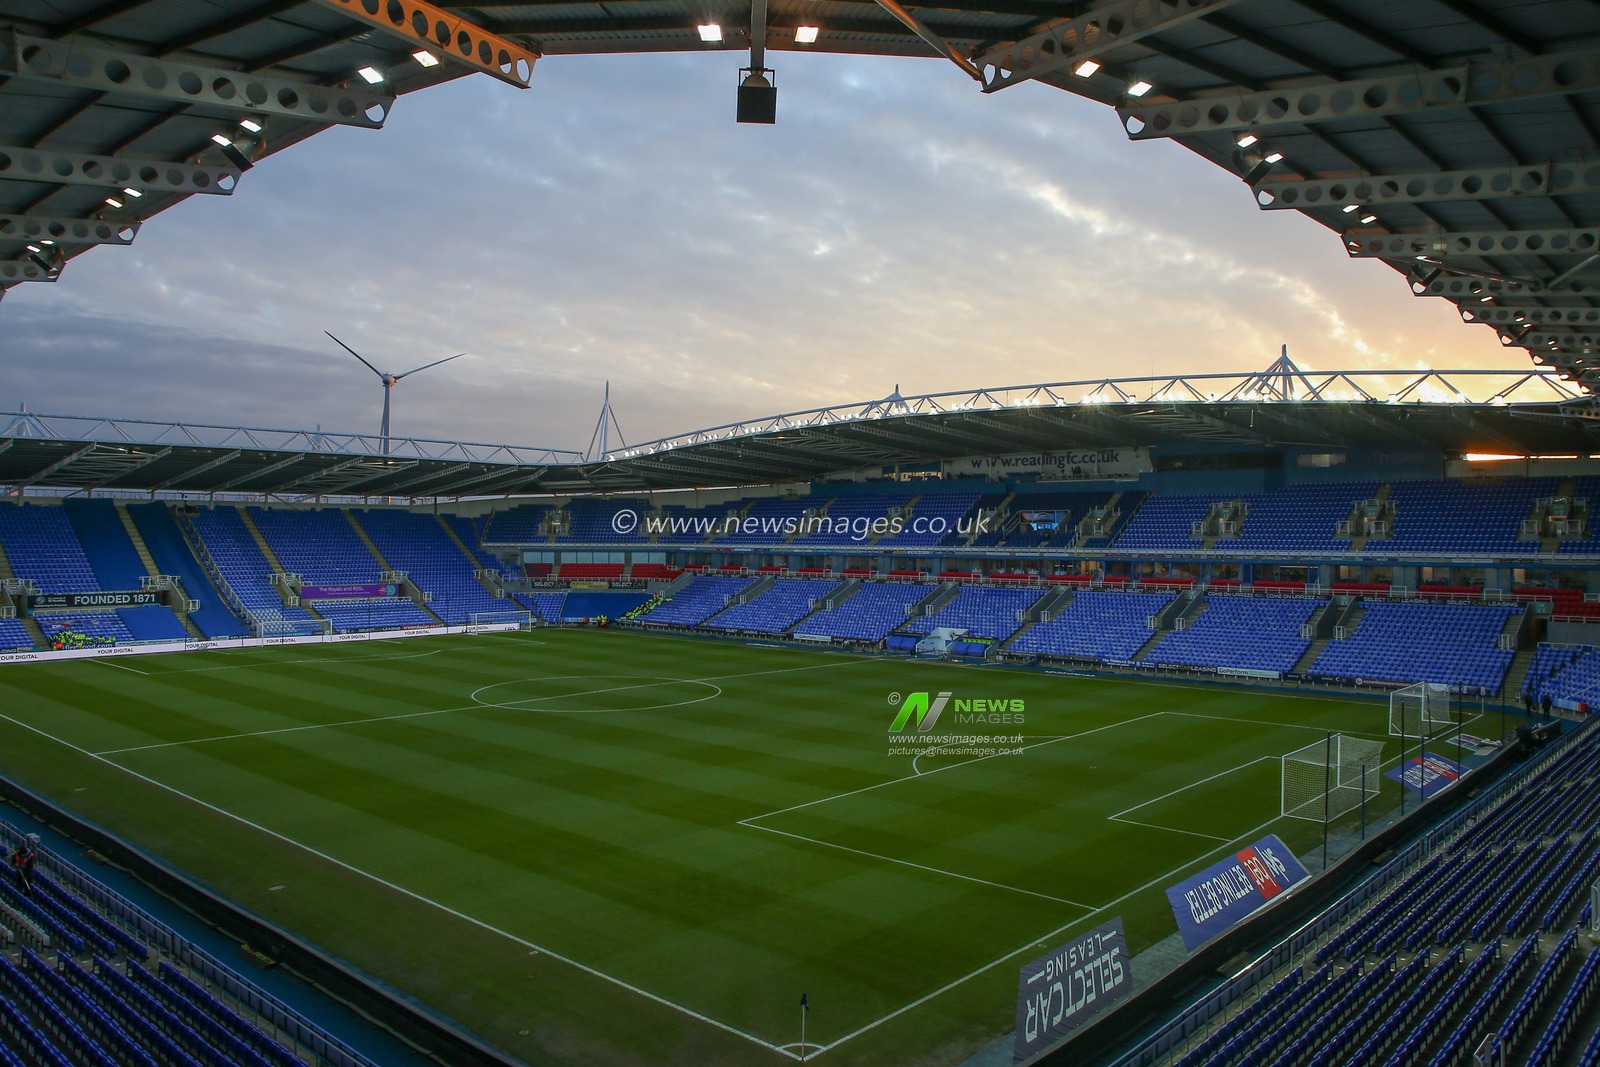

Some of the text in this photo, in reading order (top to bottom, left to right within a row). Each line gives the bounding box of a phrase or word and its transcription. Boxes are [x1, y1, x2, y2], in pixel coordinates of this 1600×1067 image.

[74, 594, 156, 605] FOUNDED 1871
[1184, 846, 1290, 924] sky bet BETTING BETTER
[1046, 933, 1102, 982] LEASING
